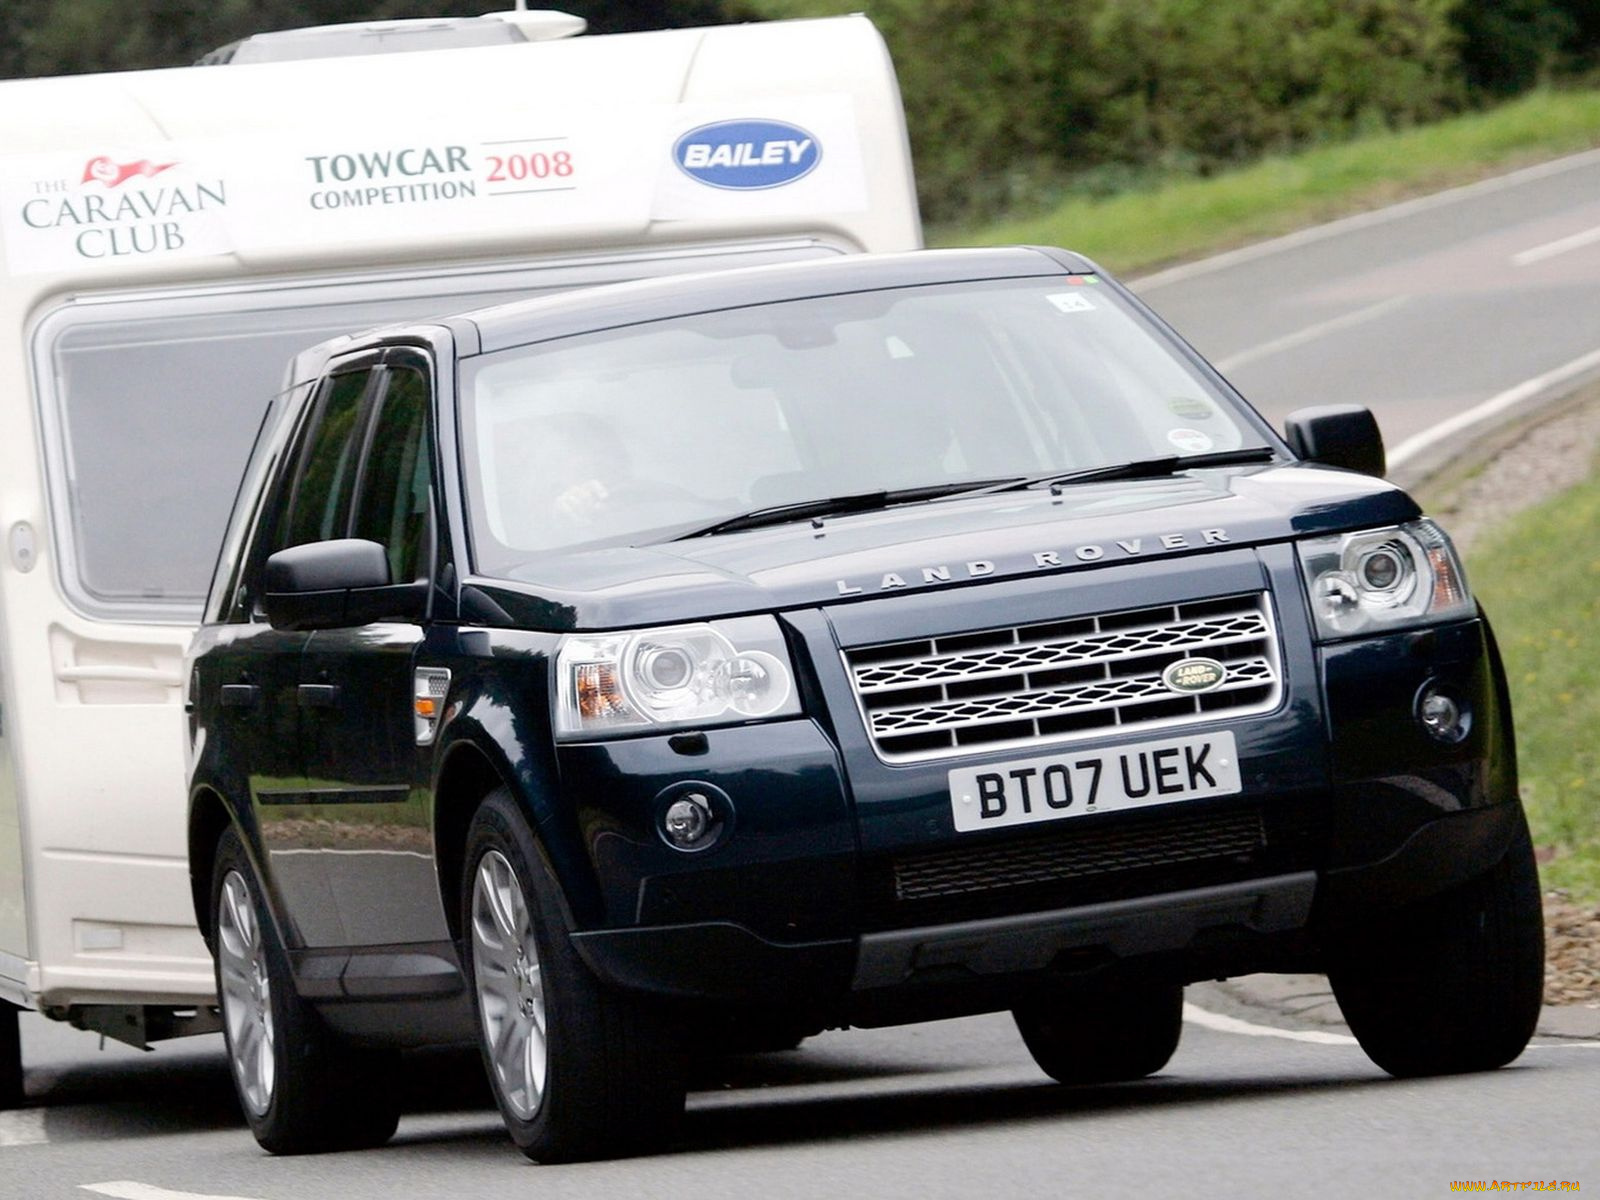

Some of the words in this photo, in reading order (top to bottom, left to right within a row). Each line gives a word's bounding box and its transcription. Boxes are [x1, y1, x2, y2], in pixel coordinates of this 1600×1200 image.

[306, 145, 472, 184] TOWCAR
[485, 151, 575, 182] 2008
[684, 139, 811, 169] BAILEY
[22, 180, 227, 229] CARAVAN
[33, 179, 68, 194] THE
[310, 180, 477, 210] COMPETITION
[75, 222, 185, 259] CLUB
[836, 560, 995, 596] LAND
[1032, 527, 1231, 567] ROVER
[976, 758, 1103, 819] BT07
[1120, 743, 1217, 799] UEK
